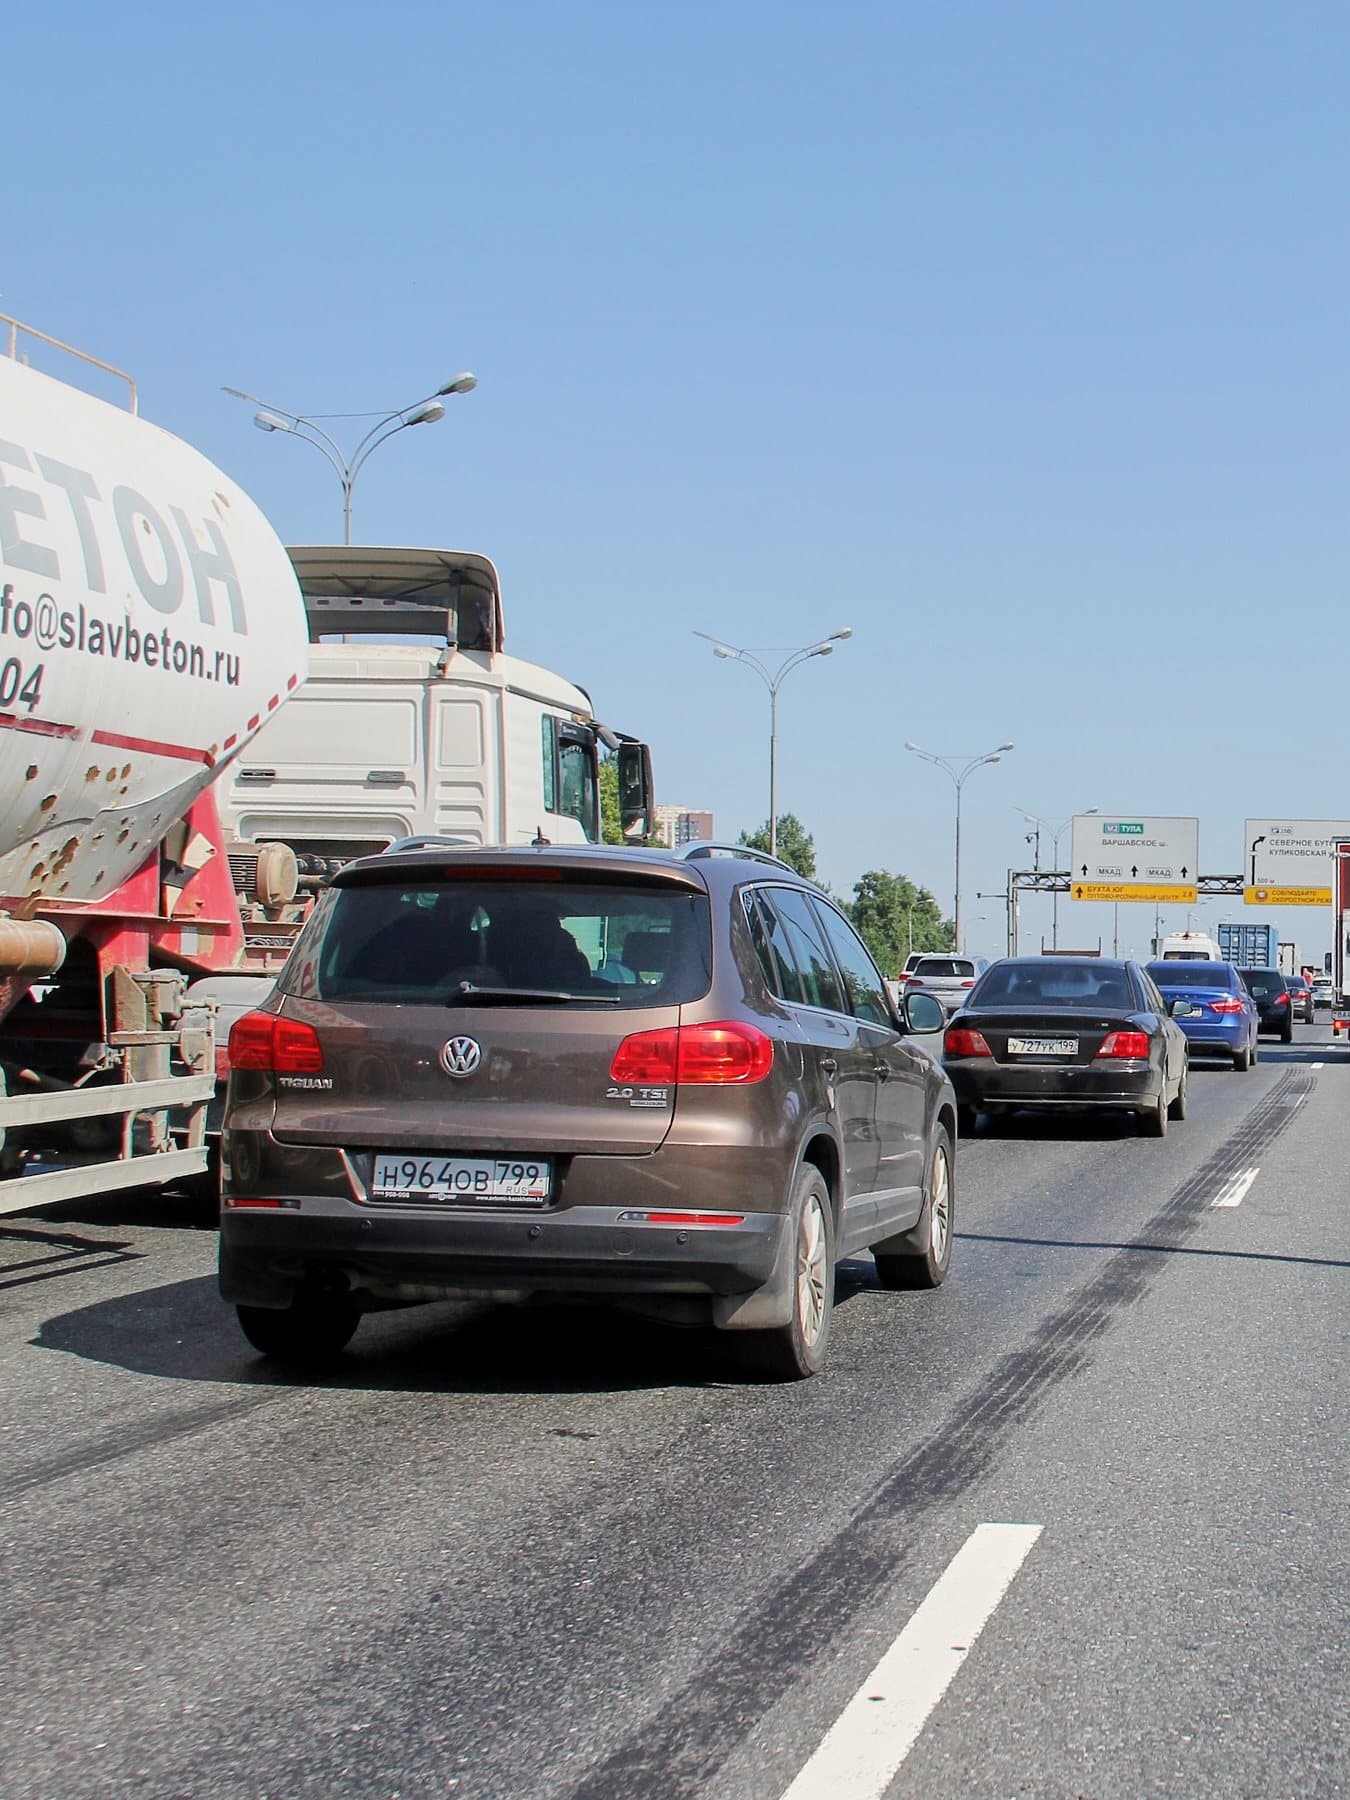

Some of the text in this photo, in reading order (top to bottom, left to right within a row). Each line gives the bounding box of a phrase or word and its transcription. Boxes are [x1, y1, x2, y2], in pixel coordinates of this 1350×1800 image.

[1101, 839, 1157, 847] ВАРШАВСКОЕ
[1098, 868, 1120, 876] МКАД
[1148, 869, 1171, 877] МКАД
[279, 1077, 333, 1089] TIGUAN
[639, 1088, 668, 1099] TSI
[497, 1163, 539, 1186] 799
[505, 1186, 528, 1195] RUS
